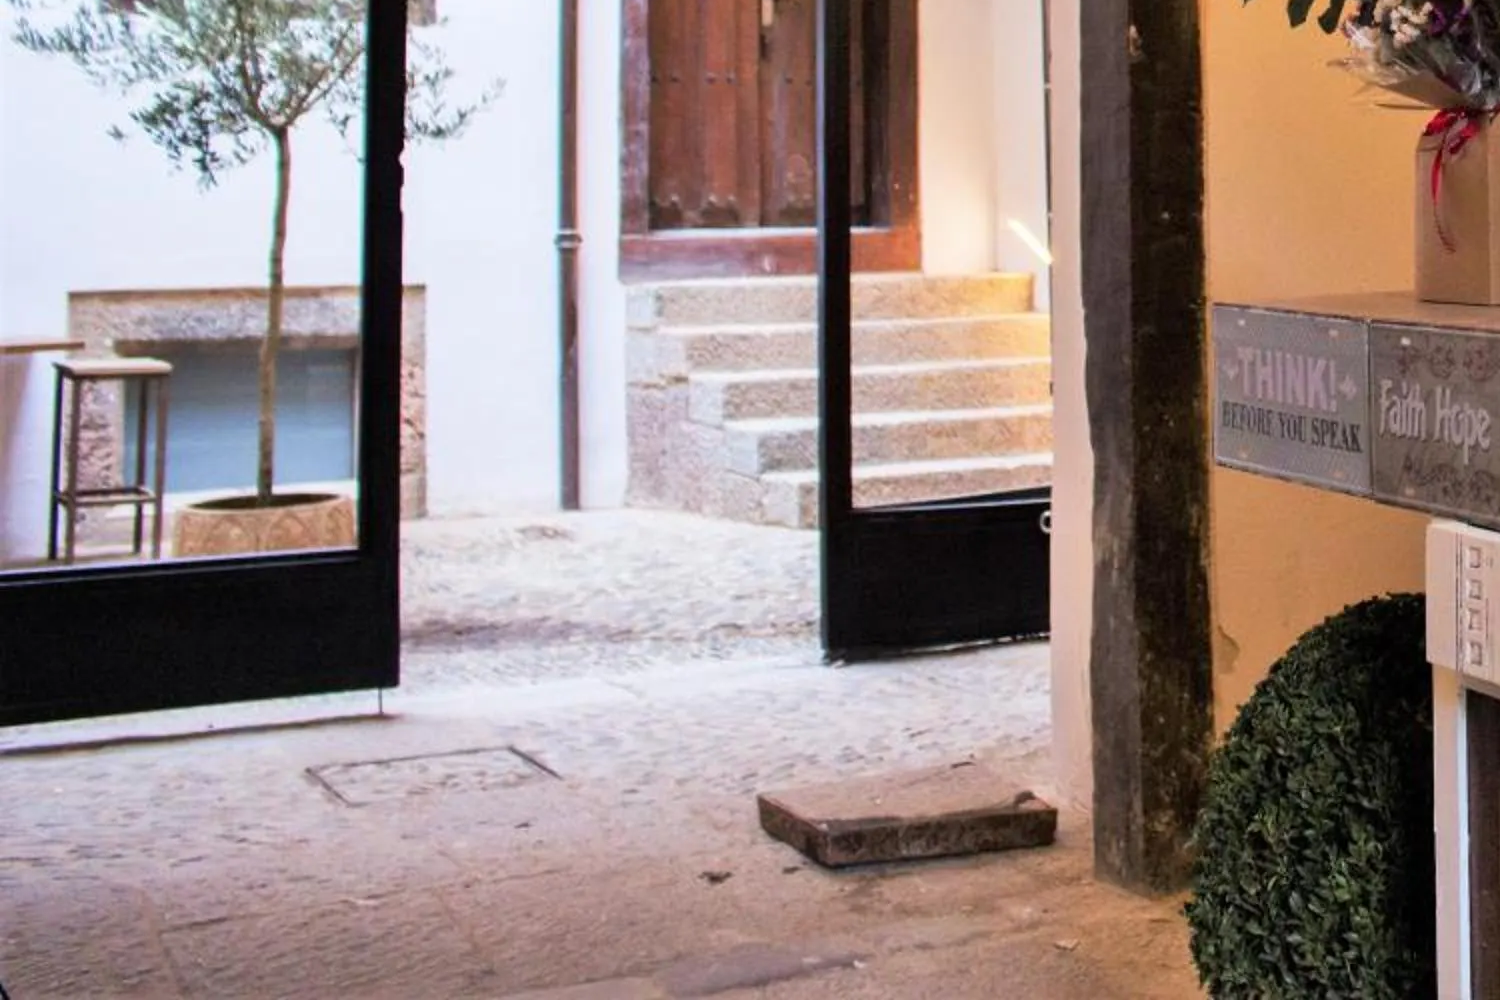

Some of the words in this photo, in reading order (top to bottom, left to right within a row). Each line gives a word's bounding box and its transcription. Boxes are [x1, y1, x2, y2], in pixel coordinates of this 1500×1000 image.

[1237, 345, 1338, 413] THINK!
[1222, 400, 1273, 437] BEFORE
[1279, 410, 1309, 445] YOU
[1311, 416, 1364, 454] SPEAK
[1378, 379, 1427, 442] Faith
[1433, 385, 1491, 465] Hope
